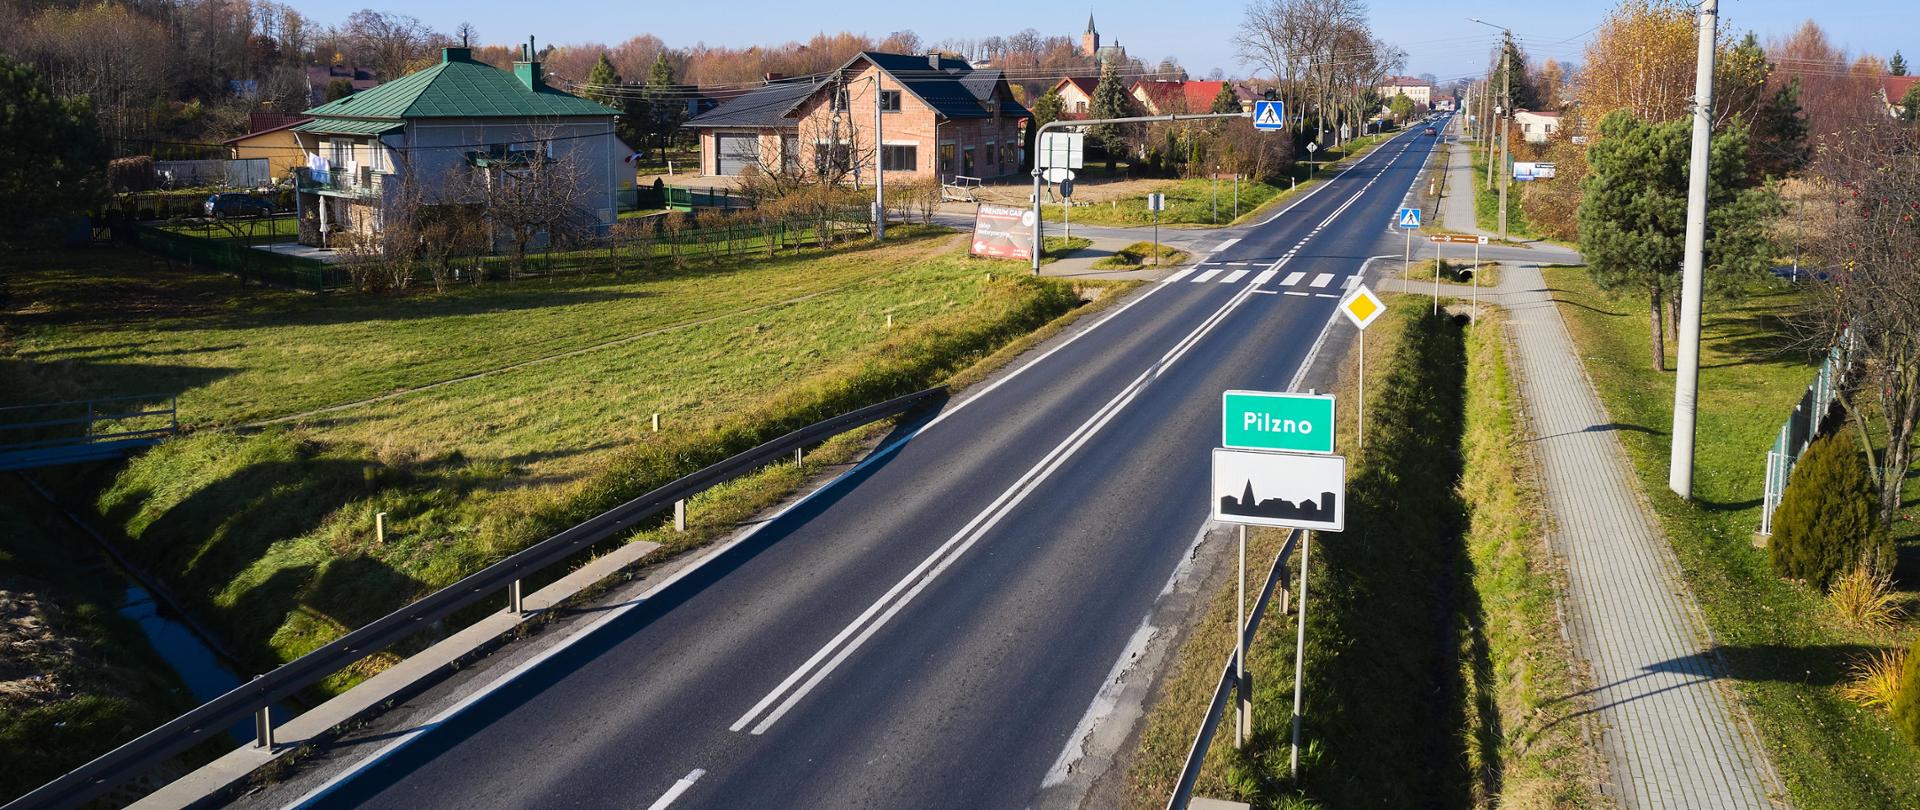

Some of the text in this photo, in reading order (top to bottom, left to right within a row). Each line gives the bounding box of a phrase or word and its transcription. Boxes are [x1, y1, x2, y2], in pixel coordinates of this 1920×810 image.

[981, 207, 1023, 217] PREMIUM CAR
[1243, 411, 1313, 435] Pilzno
